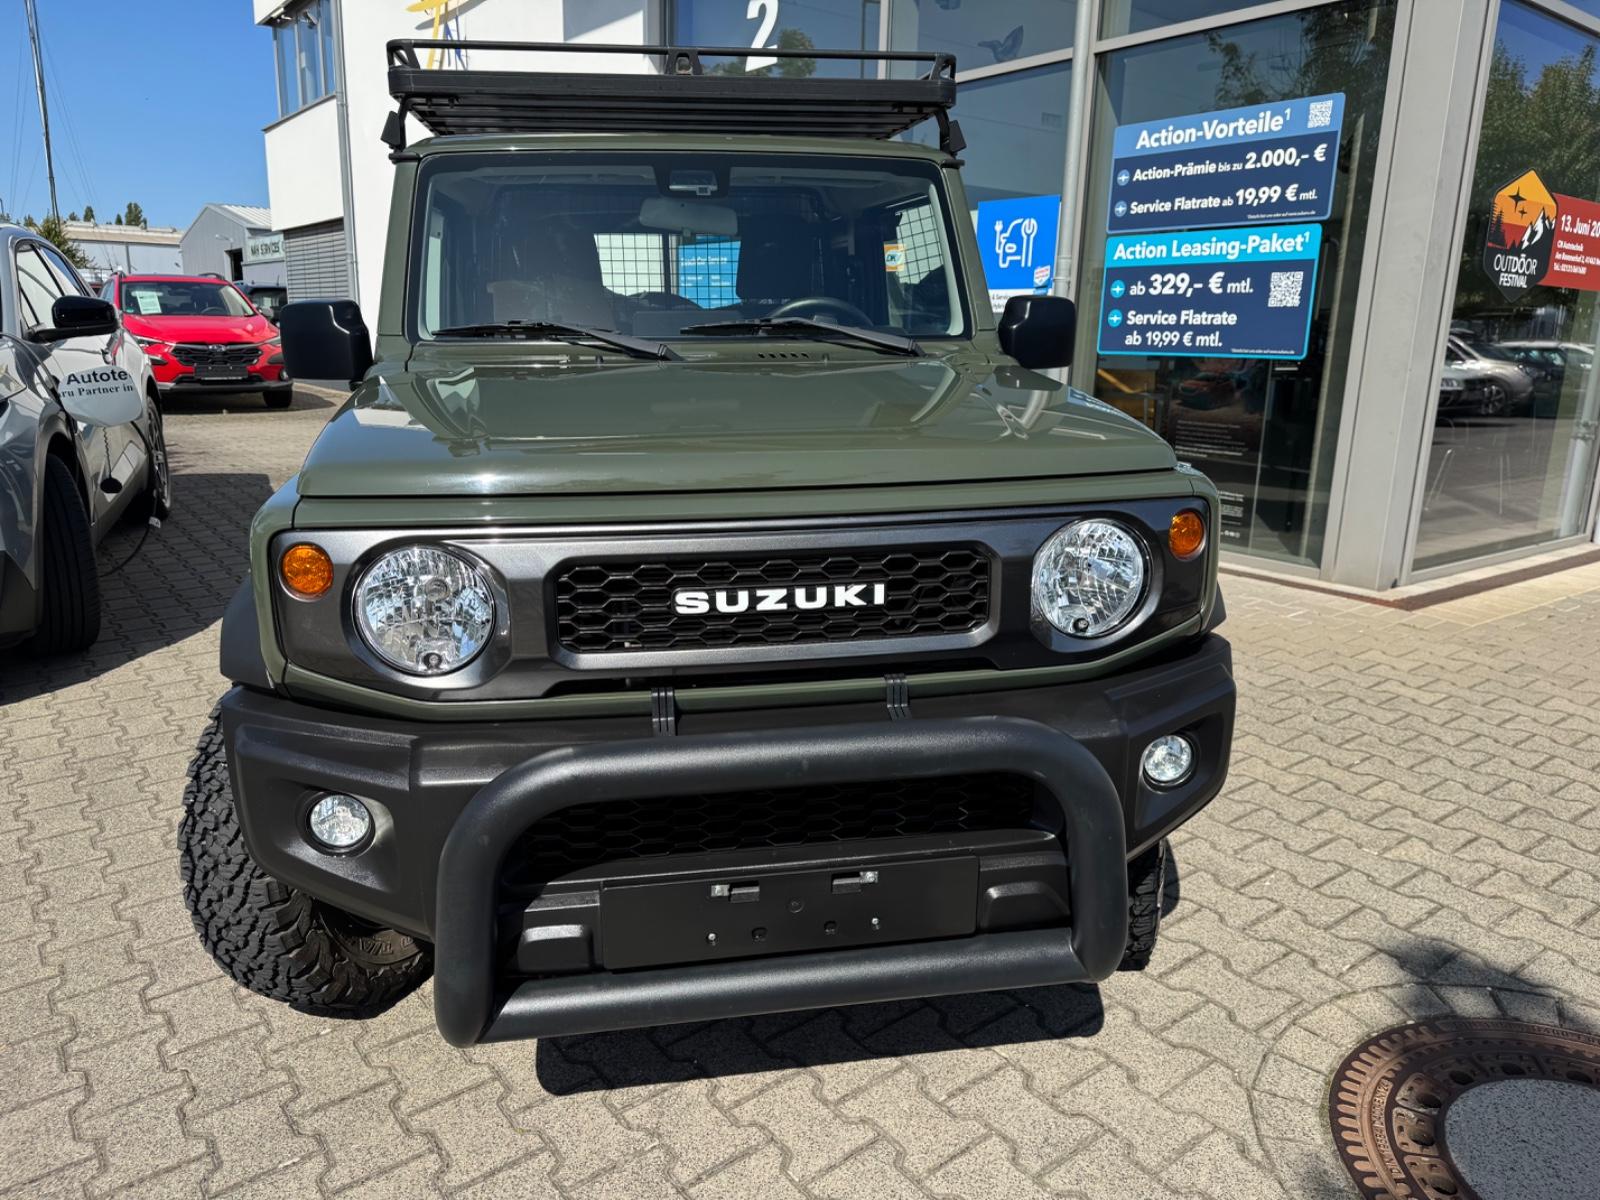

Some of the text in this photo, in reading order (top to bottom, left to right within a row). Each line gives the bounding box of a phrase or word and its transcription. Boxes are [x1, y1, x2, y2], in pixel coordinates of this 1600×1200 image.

[745, 0, 779, 73] 2
[1132, 160, 1217, 182] Action-Prämie
[1218, 162, 1231, 172] bis
[1232, 162, 1243, 171] zu
[1313, 143, 1328, 162] €
[1129, 183, 1318, 215] Service Flatrate ab 19,99 € mtl.
[1561, 213, 1573, 233] 13.
[1573, 216, 1592, 236] Juni
[1113, 239, 1167, 261] Action
[1129, 280, 1146, 296] ab
[1208, 271, 1225, 295] €
[1227, 278, 1254, 294] mtl.
[1499, 273, 1527, 288] FESTIVAL
[1126, 309, 1238, 326] Service Flatrate
[1124, 331, 1223, 348] ab 19,99 € mtl.
[66, 368, 131, 385] Autote
[77, 386, 120, 397] Partner
[122, 383, 133, 393] in
[674, 583, 886, 615] SUZUKI
